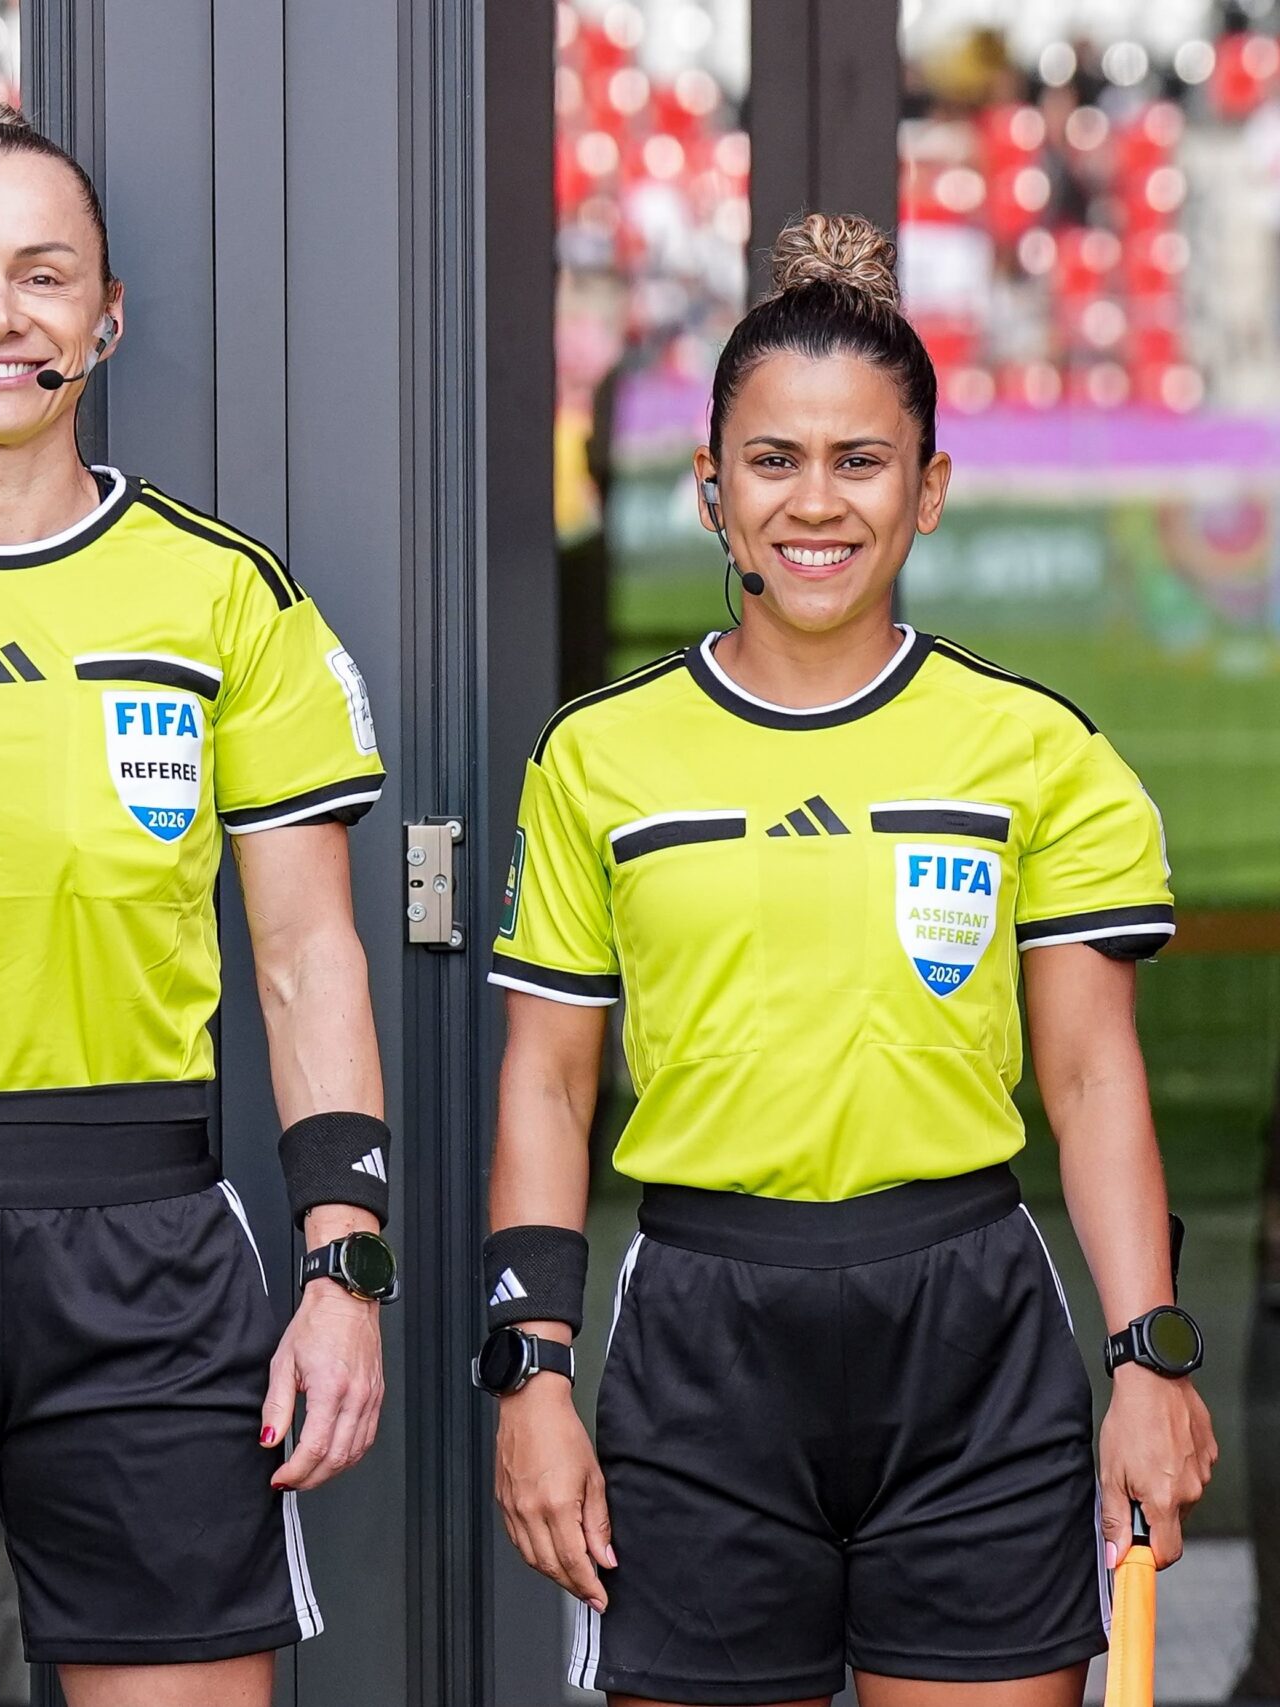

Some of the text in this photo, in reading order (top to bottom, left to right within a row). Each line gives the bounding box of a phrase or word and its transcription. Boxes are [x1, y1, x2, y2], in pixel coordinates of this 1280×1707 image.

[115, 702, 198, 739] FIFA
[120, 761, 197, 782] REFEREE
[148, 811, 186, 828] 2026
[908, 855, 992, 896] FIFA
[908, 907, 989, 929] ASSISTANT
[915, 924, 981, 946] REFEREE
[927, 965, 961, 984] 2026
